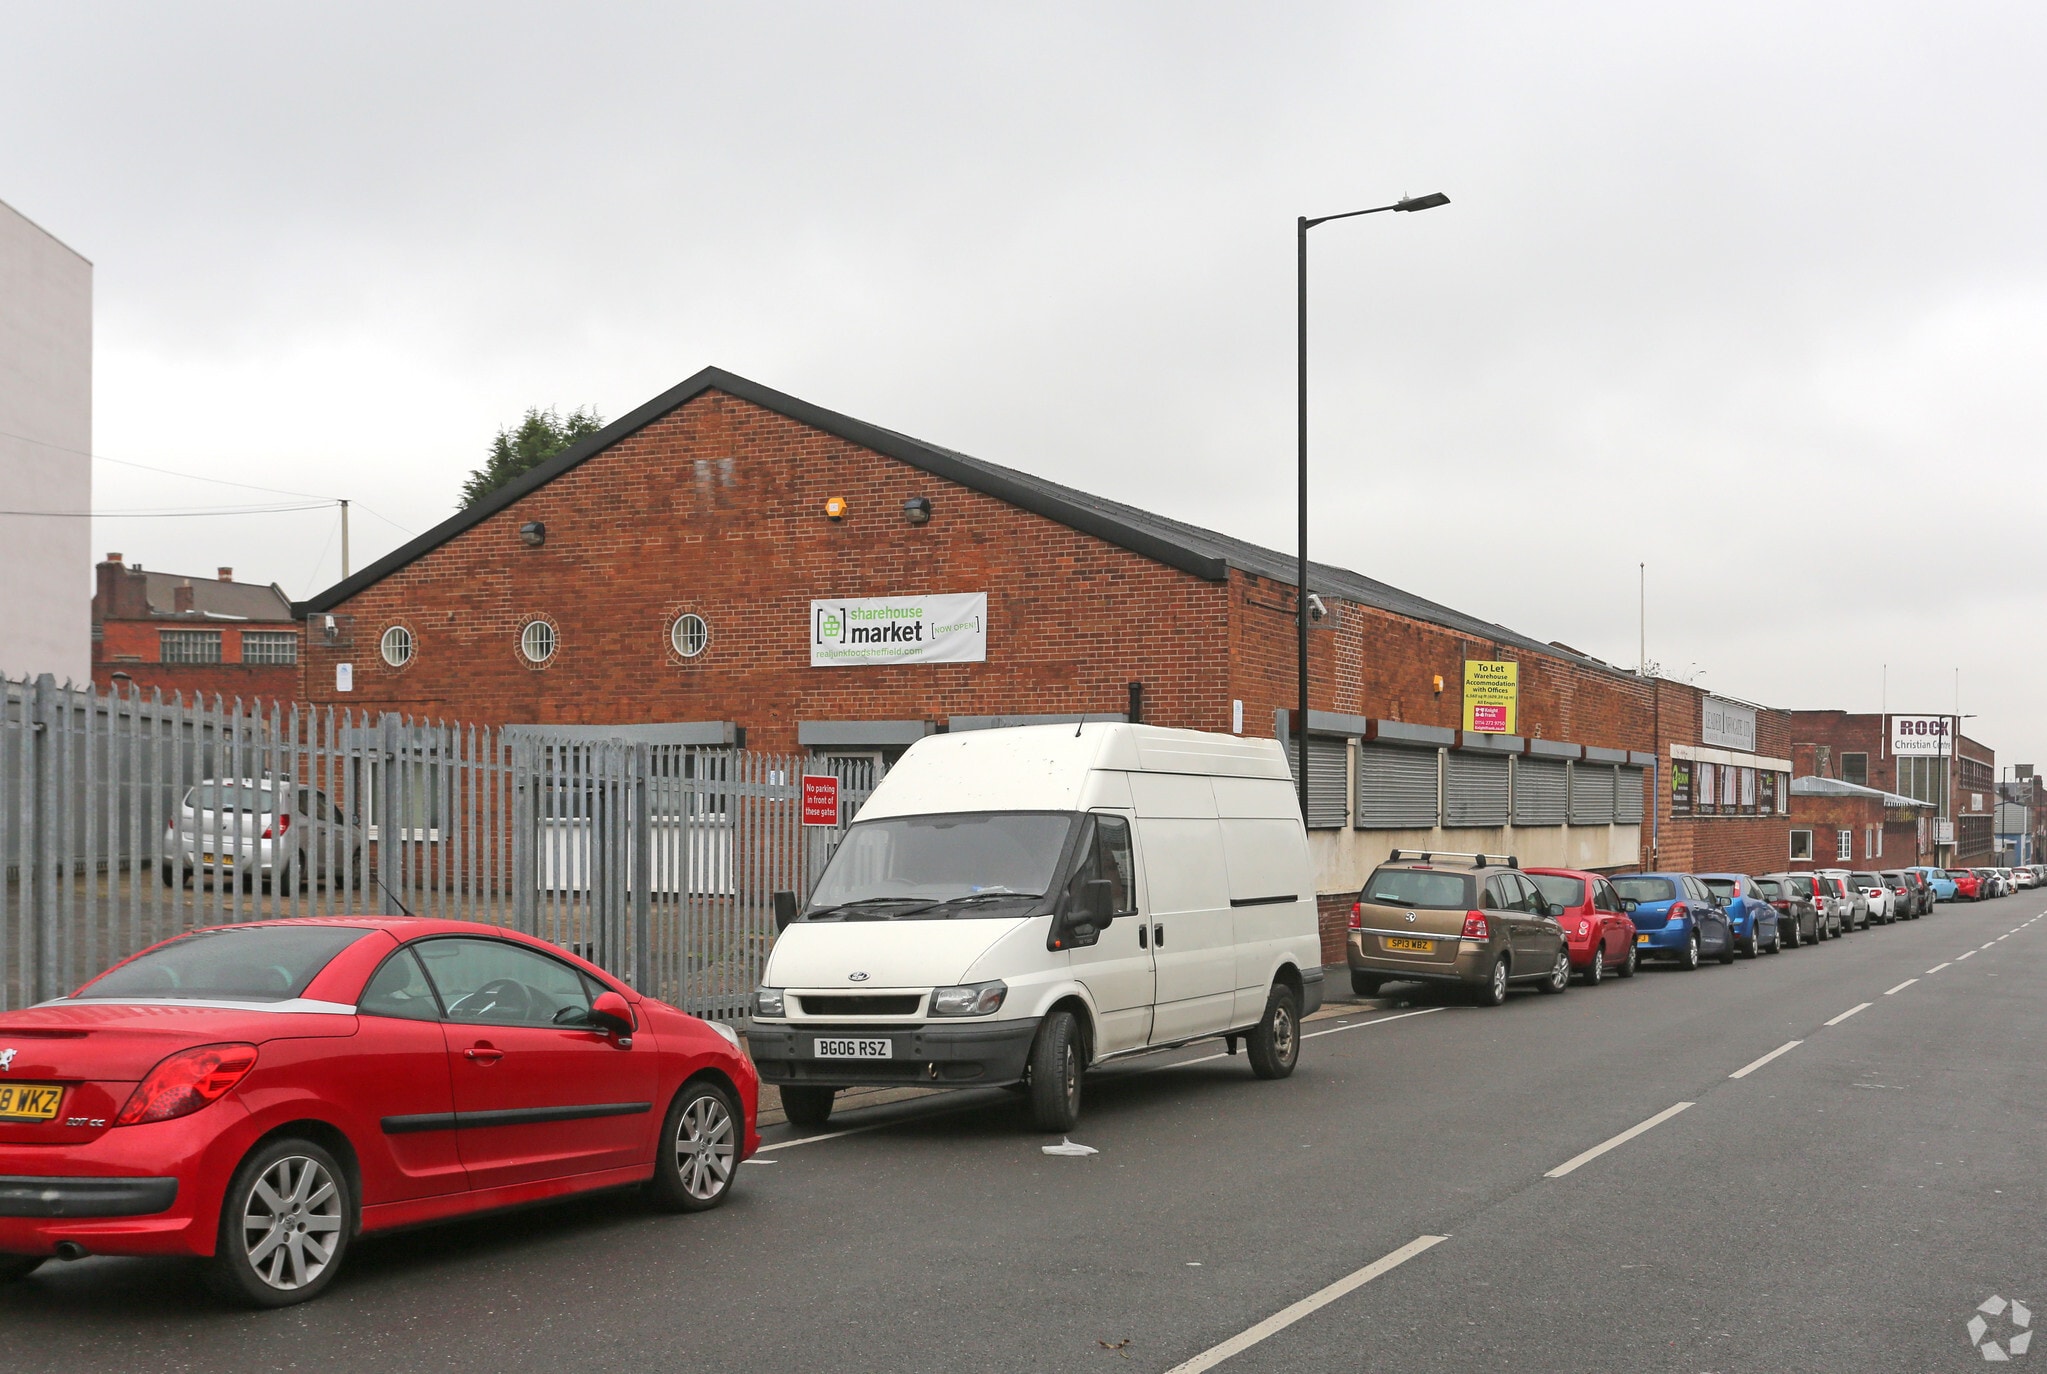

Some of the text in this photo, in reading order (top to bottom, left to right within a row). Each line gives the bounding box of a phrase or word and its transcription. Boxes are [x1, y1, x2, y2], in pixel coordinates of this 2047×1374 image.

[851, 606, 923, 620] sharehouse
[851, 621, 923, 643] market
[816, 647, 923, 660] realjunkfoodsheffield.com
[1478, 664, 1504, 673] To Let
[1900, 720, 1949, 736] ROCK
[1895, 740, 1931, 749] Christian
[806, 784, 835, 795] No parking
[807, 795, 834, 804] in front of
[806, 807, 836, 817] these gates
[1392, 939, 1427, 949] SP13 WBZ
[820, 1040, 886, 1056] BG06 RSZ
[0, 1088, 58, 1113] 8 WKZ
[65, 1117, 88, 1126] 207
